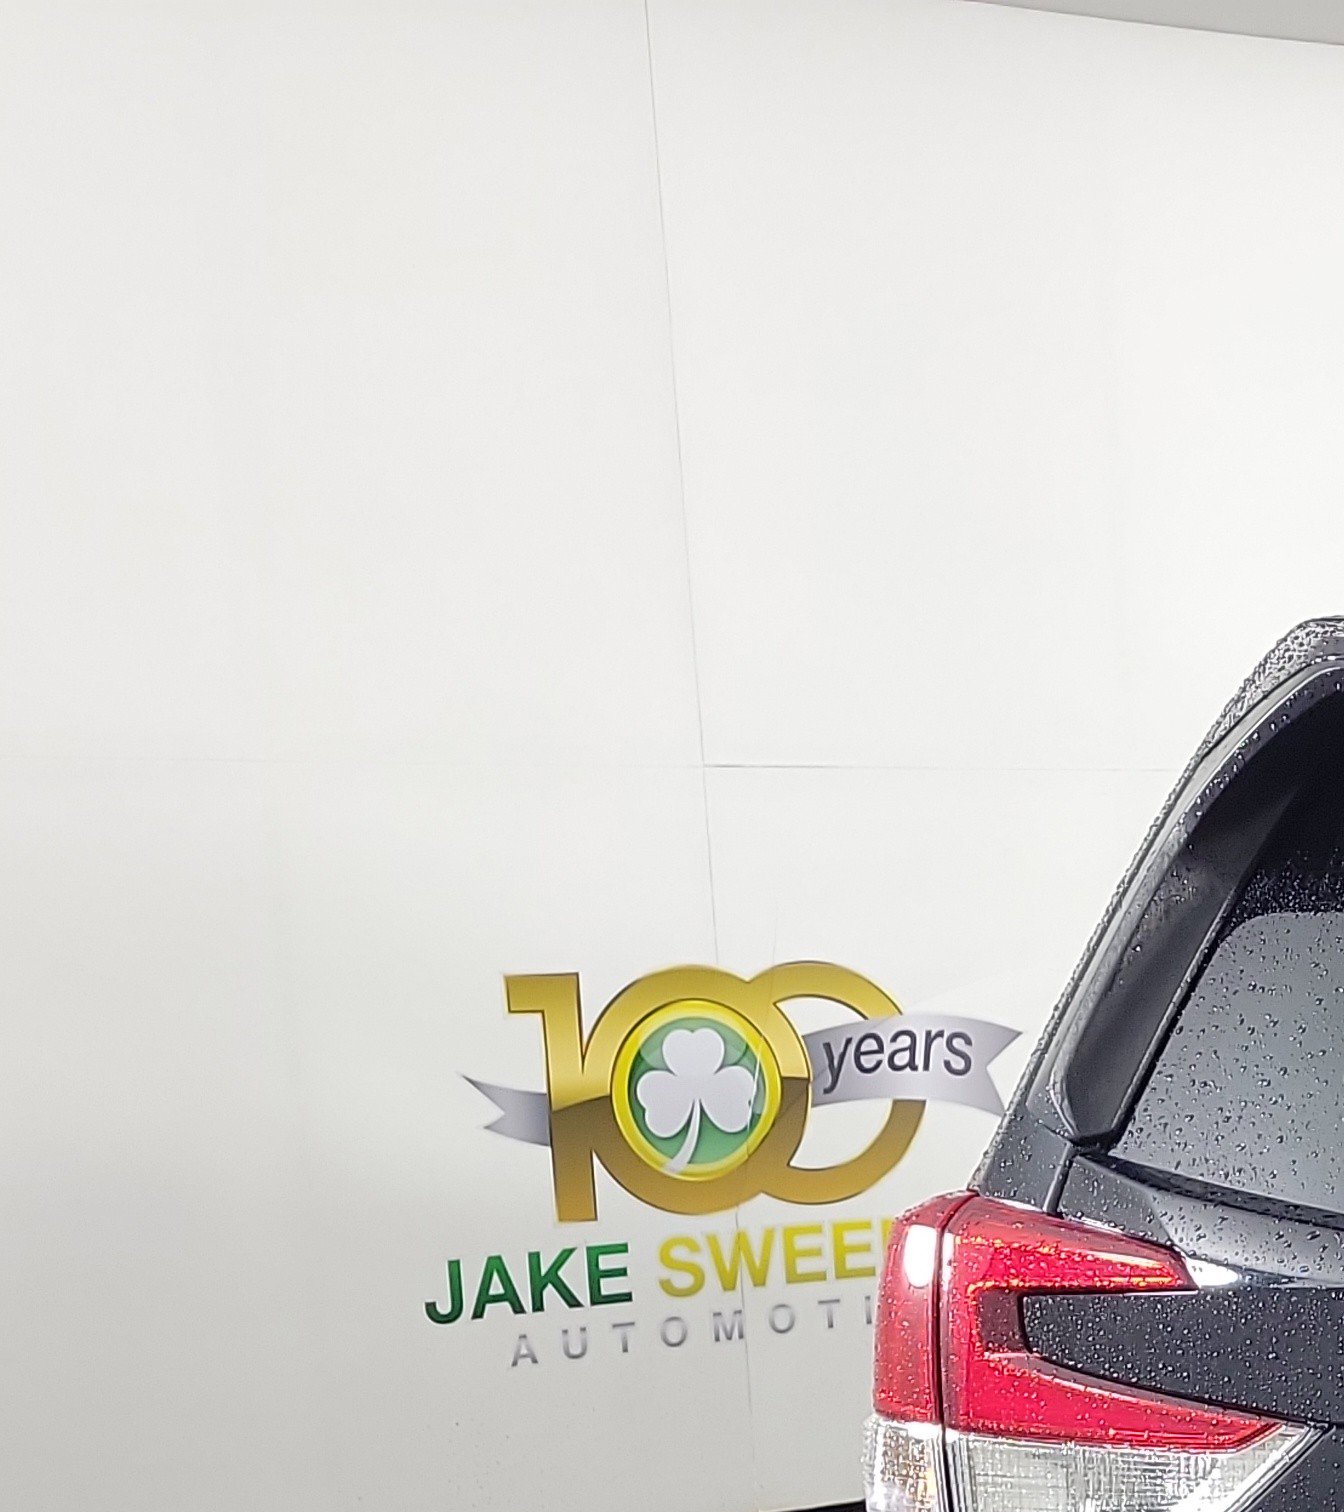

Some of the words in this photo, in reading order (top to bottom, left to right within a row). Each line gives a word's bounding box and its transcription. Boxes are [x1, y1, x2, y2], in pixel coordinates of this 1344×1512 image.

[503, 960, 928, 1223] 100
[822, 1027, 974, 1095] years
[424, 1241, 634, 1326] JAKE
